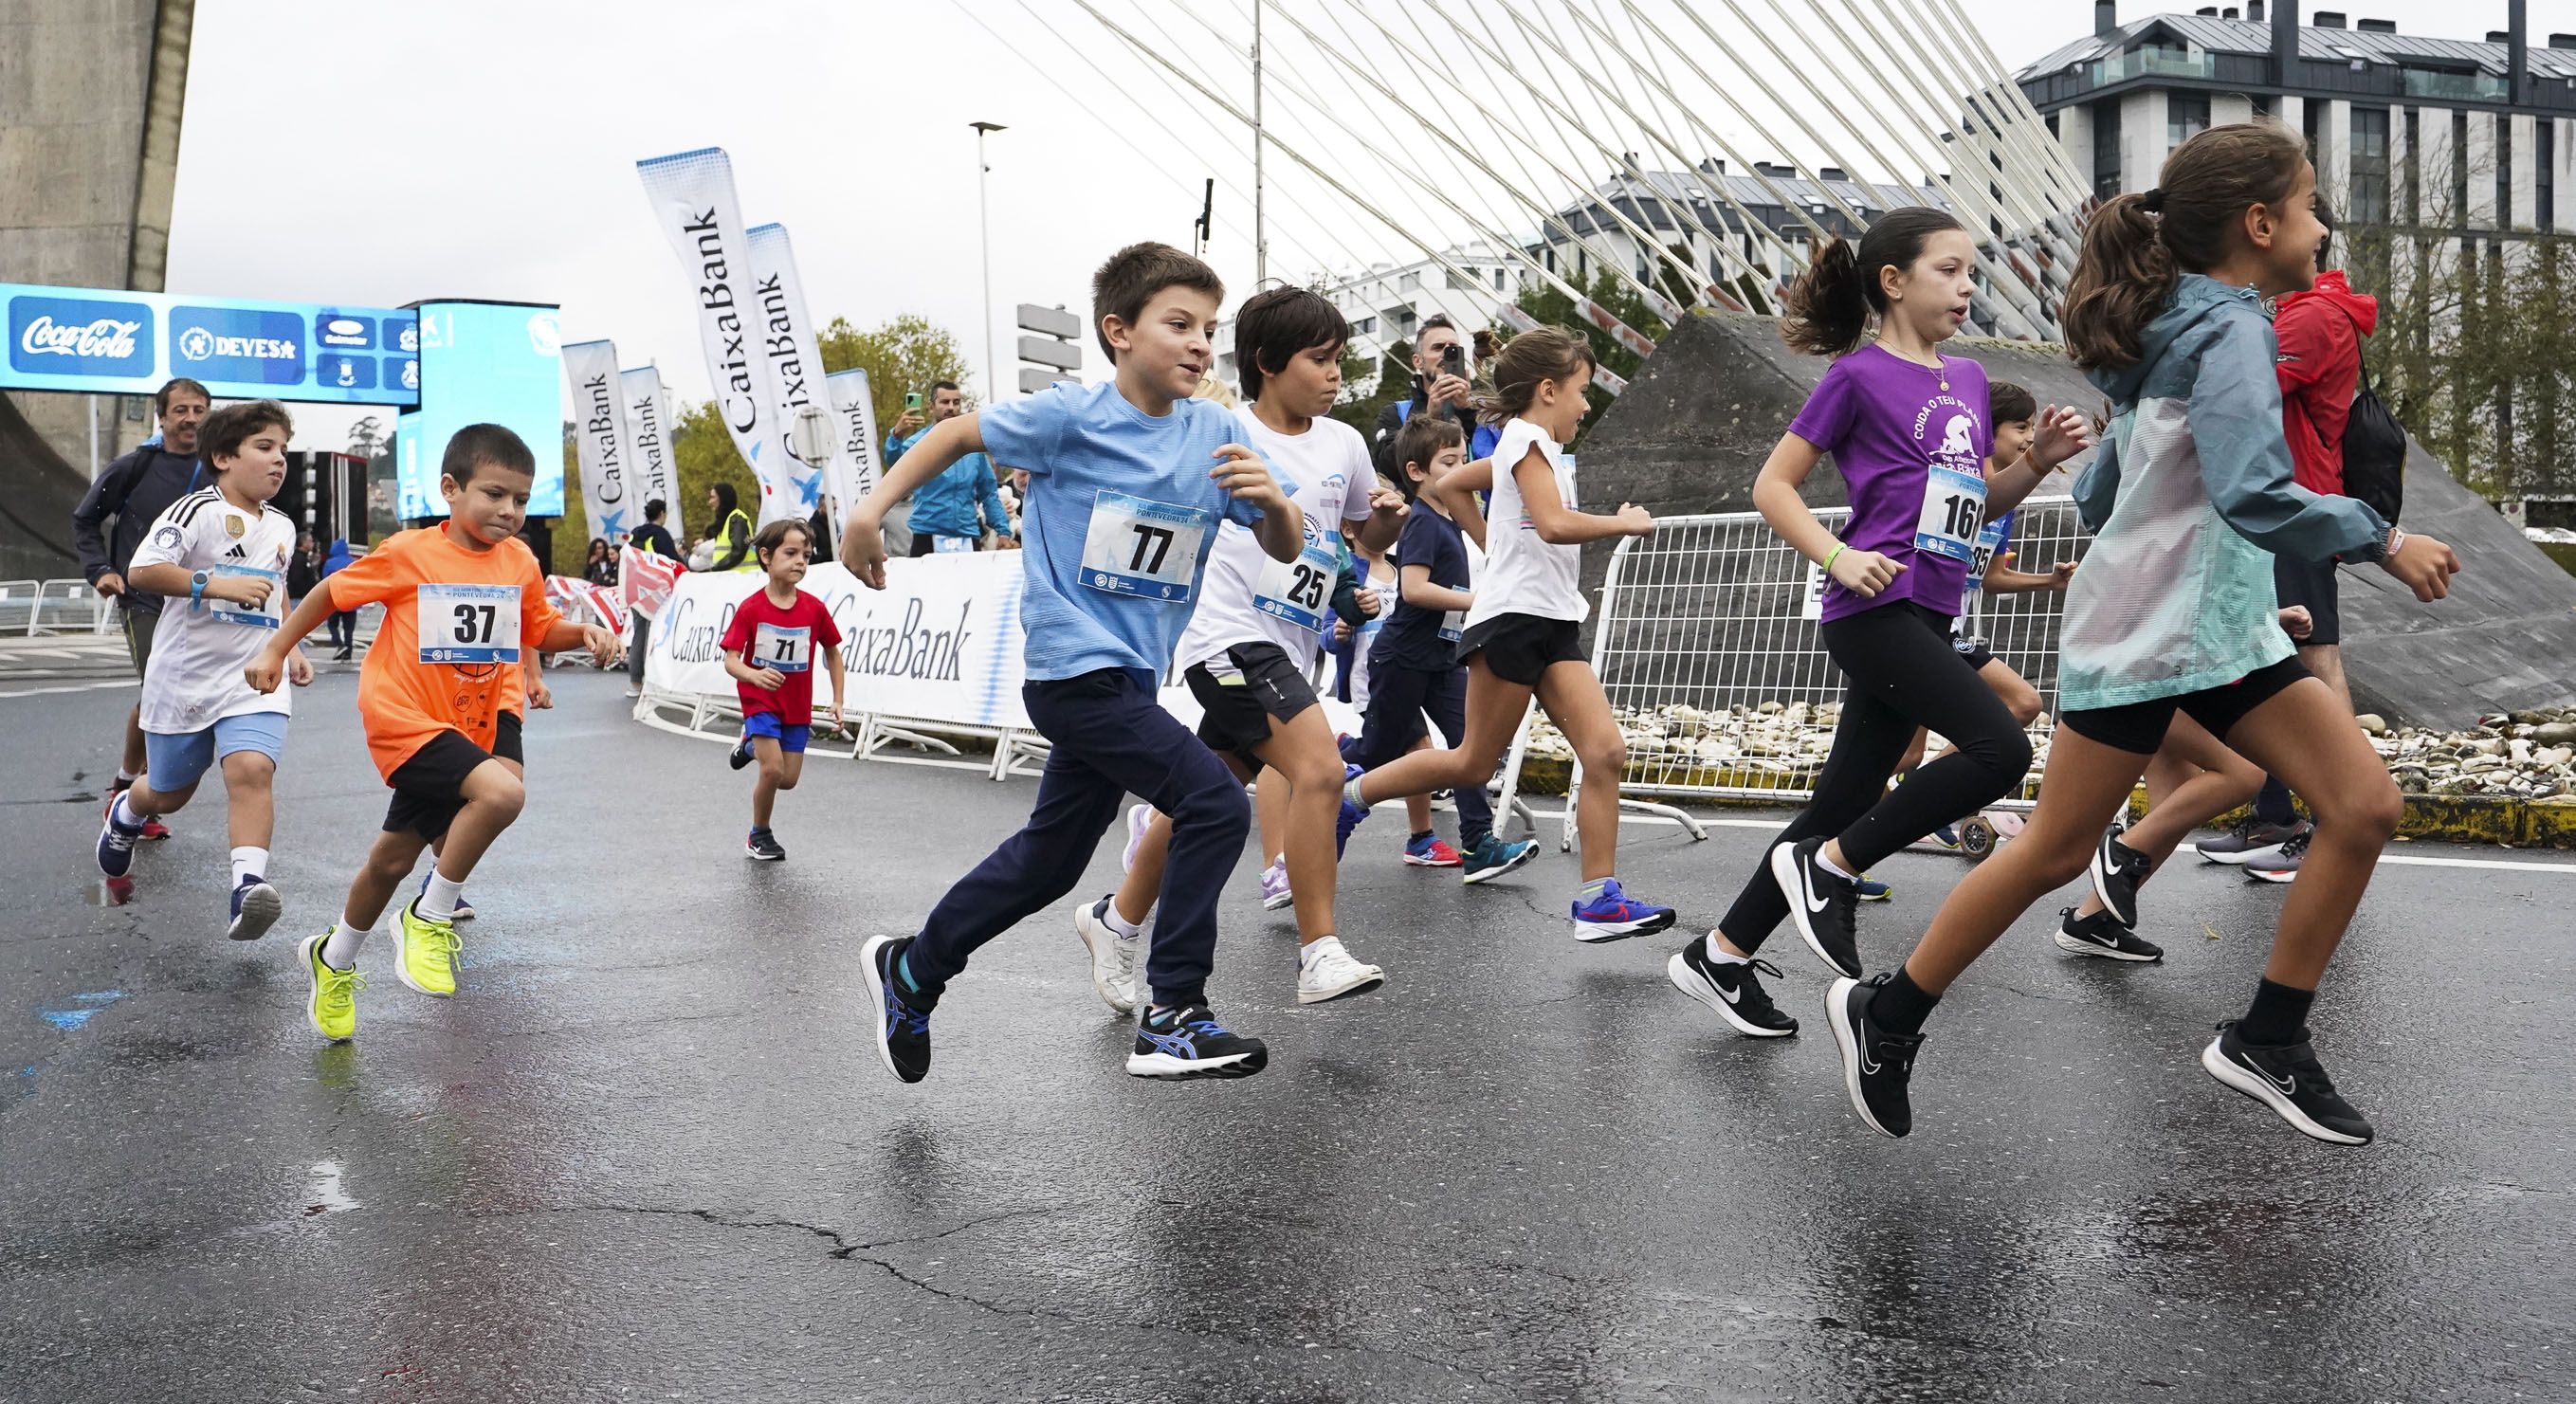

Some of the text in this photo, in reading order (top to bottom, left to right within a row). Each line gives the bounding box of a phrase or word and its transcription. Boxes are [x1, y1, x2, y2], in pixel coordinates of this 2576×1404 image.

[684, 206, 756, 433] CaixaBank
[758, 271, 809, 463] ixaBank
[584, 373, 623, 504] CaixaBank
[1914, 407, 1932, 440] COIDA
[1928, 399, 1937, 409] O
[1936, 395, 1955, 405] TEU
[843, 400, 872, 506] aixaBank
[1136, 508, 1179, 522] PONTEVEDRA
[1129, 524, 1174, 574] 77
[1287, 564, 1326, 610] 25
[454, 604, 496, 643] 37
[776, 638, 795, 662] 71
